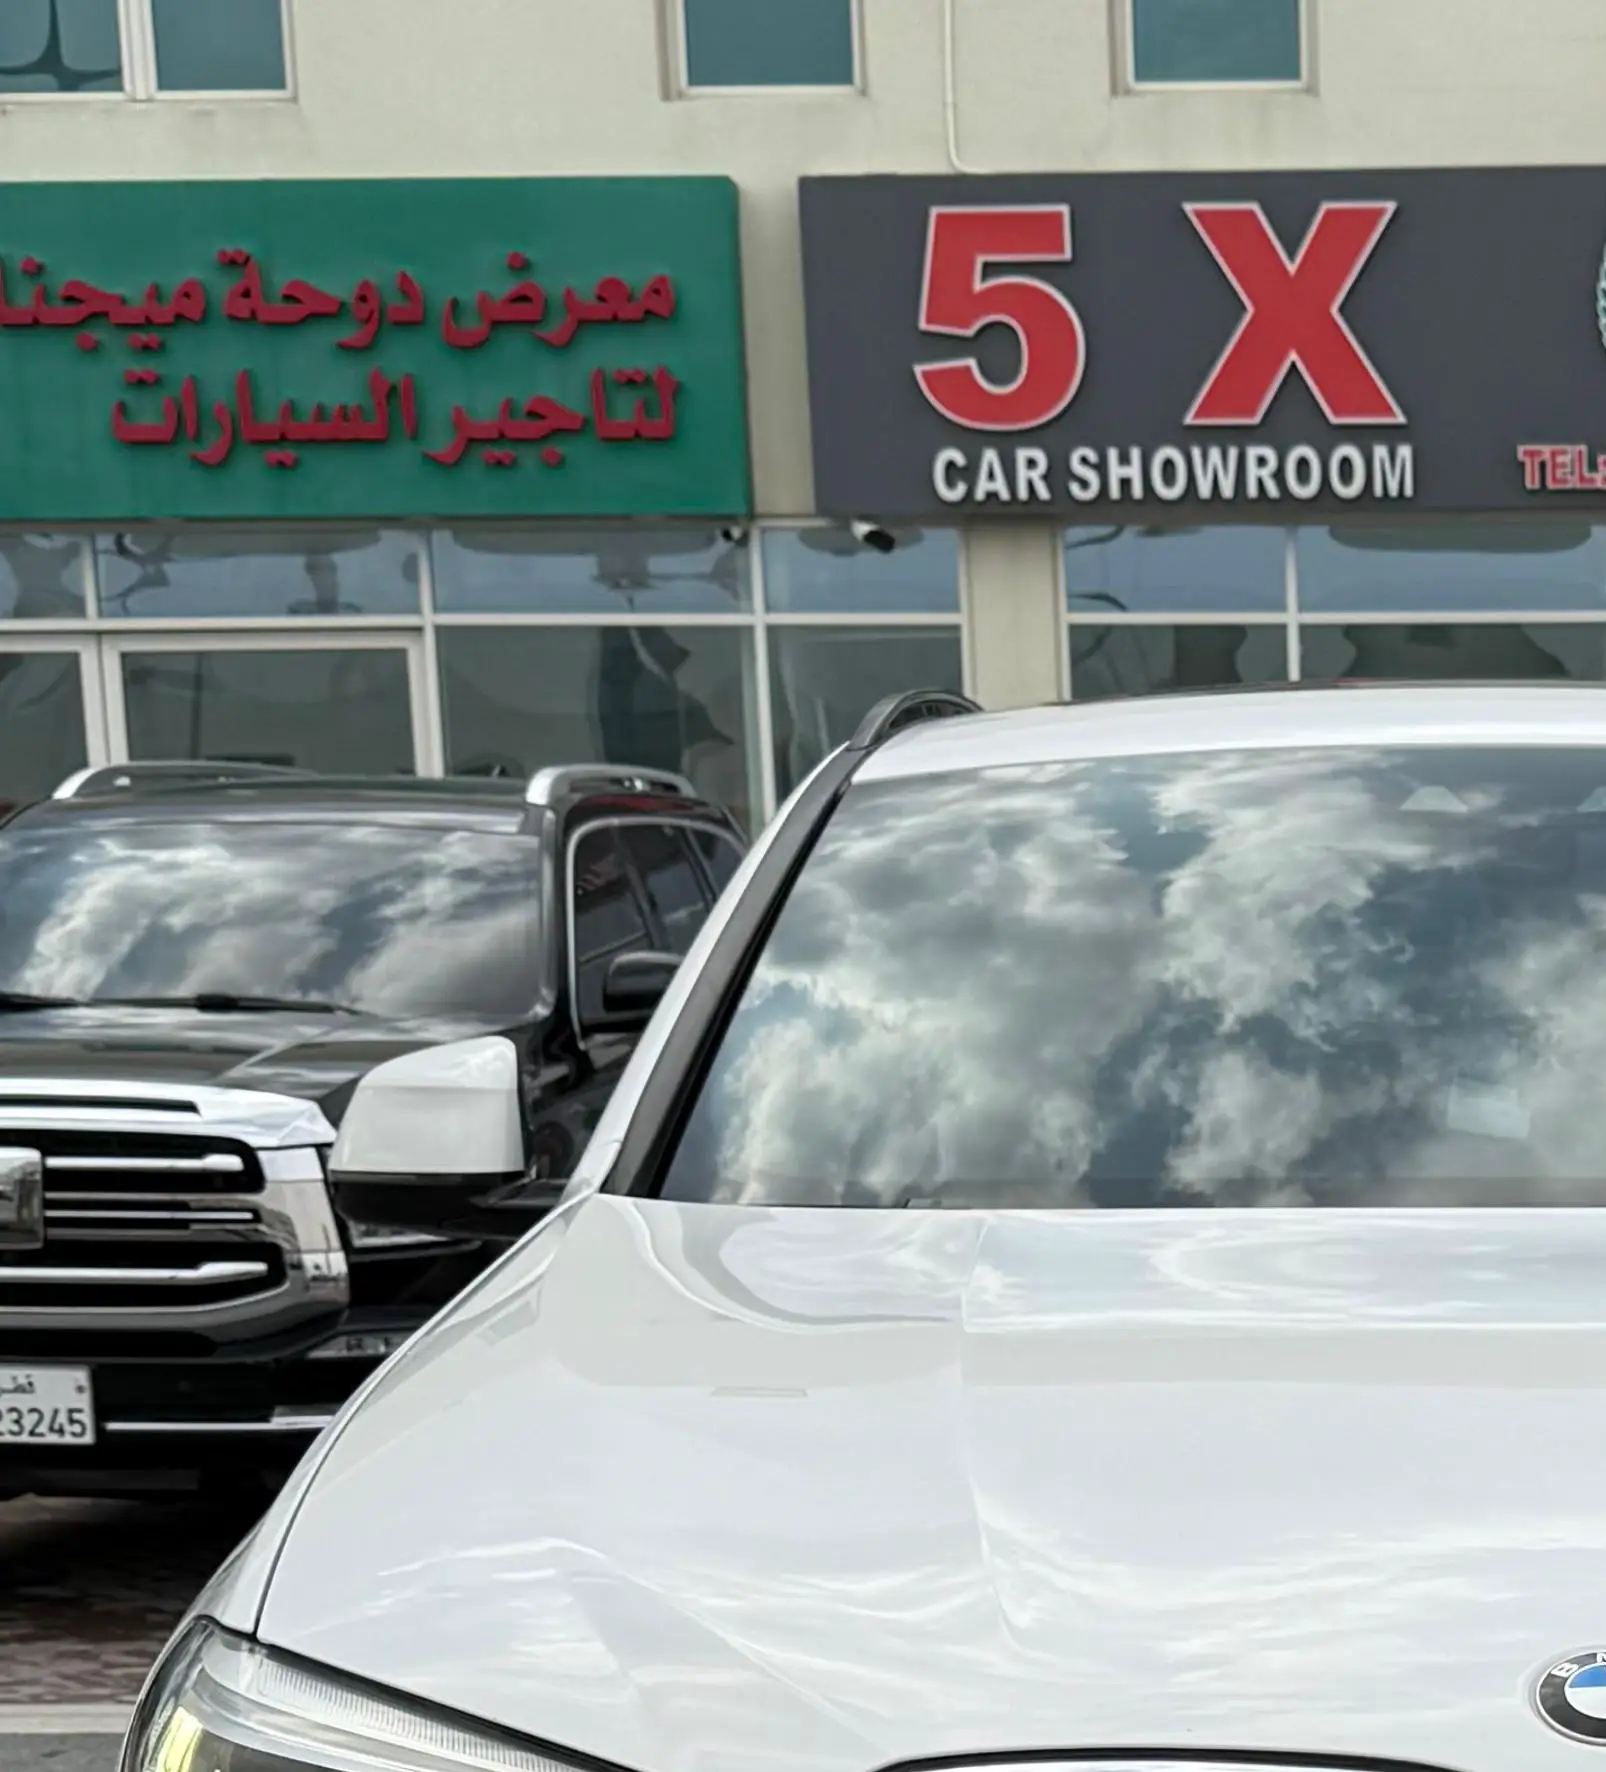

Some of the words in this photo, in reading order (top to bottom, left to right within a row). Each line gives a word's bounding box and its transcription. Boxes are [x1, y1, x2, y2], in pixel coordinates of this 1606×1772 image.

[217, 249, 425, 349] دوحة
[442, 252, 677, 348] معرض
[912, 203, 1086, 432] 5
[1181, 199, 1408, 425] X
[112, 368, 417, 467] السيارات
[424, 367, 680, 467] لتاجير
[932, 446, 1051, 502] CAR
[1068, 443, 1414, 501] SHOWROOM
